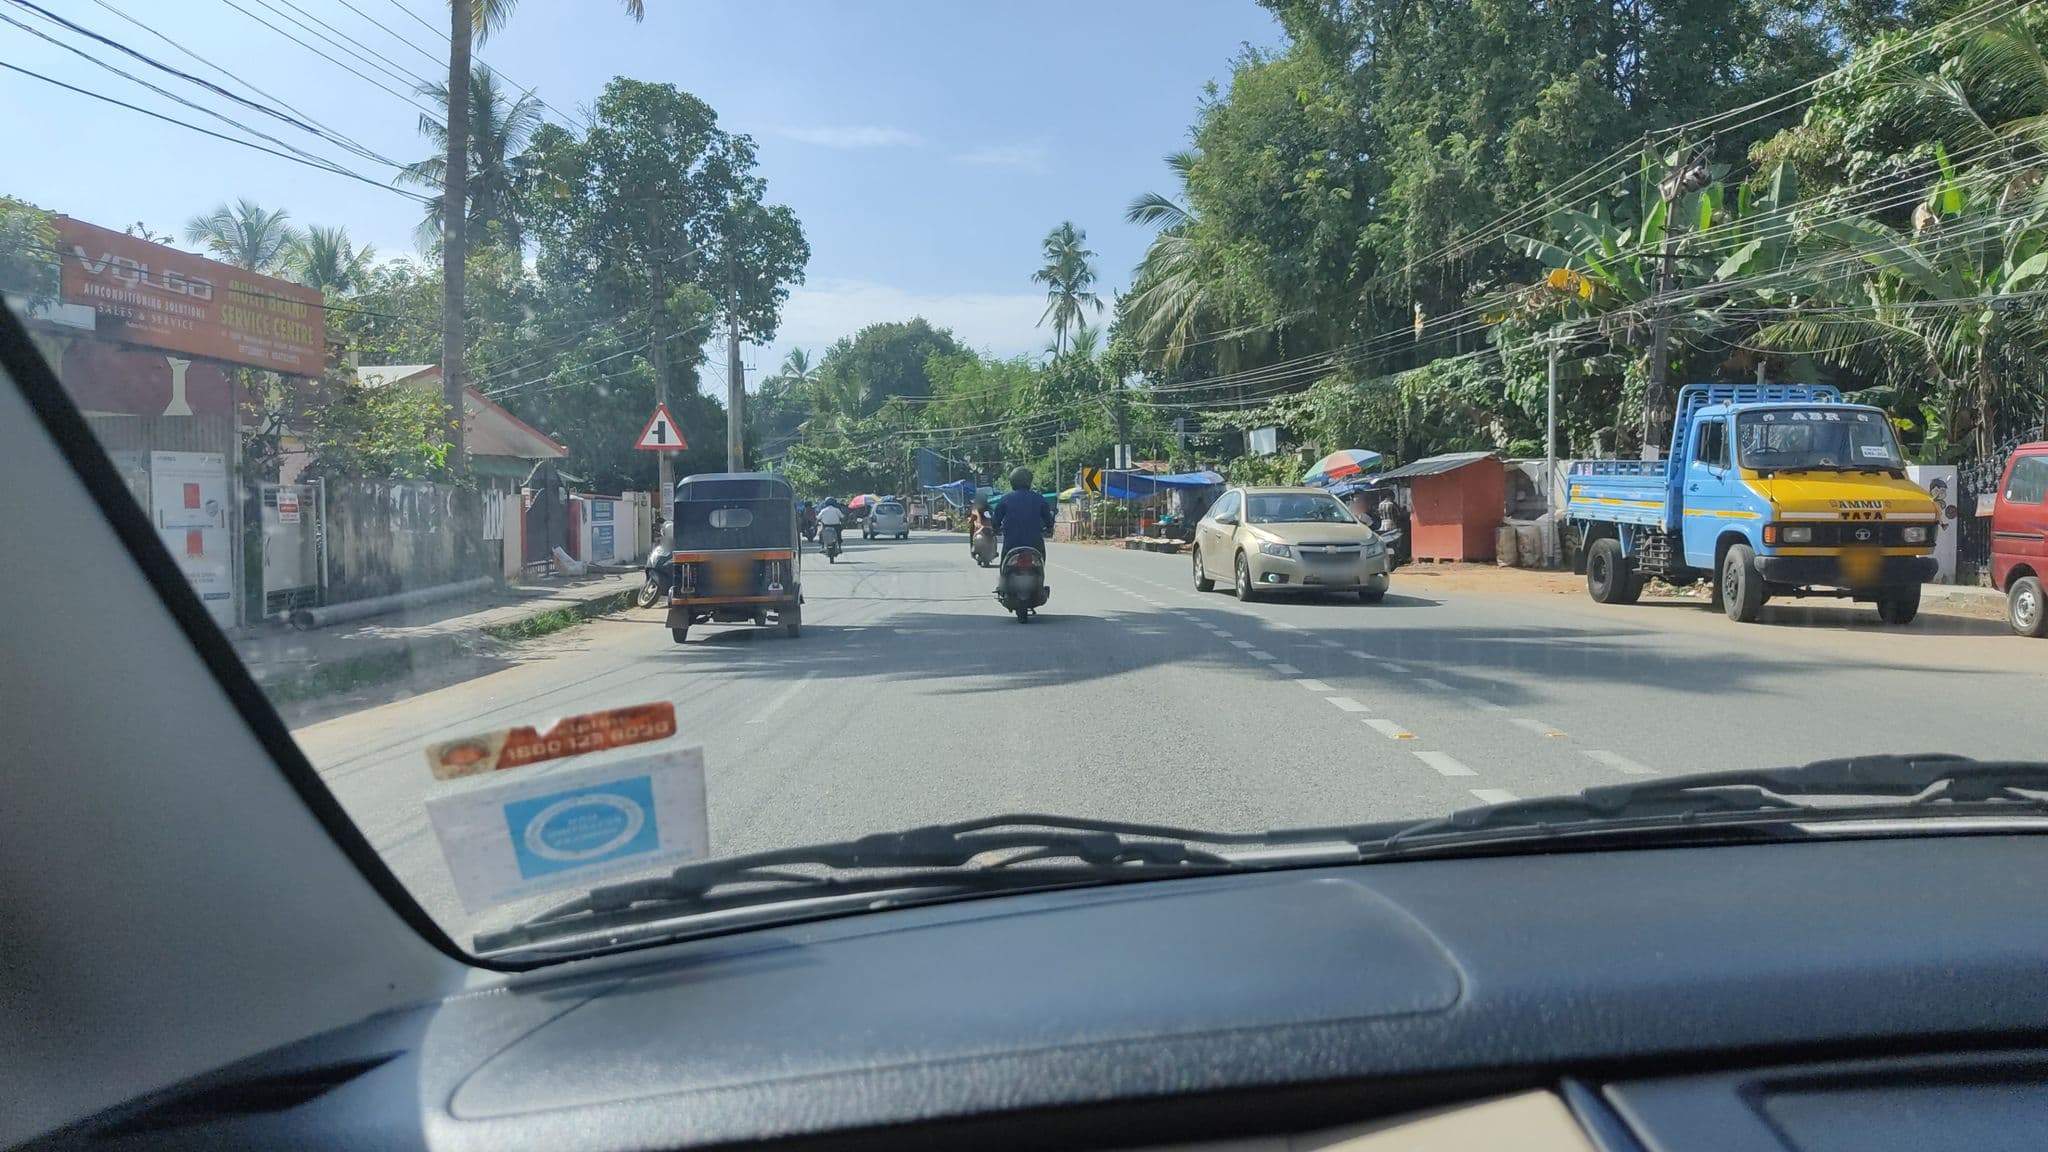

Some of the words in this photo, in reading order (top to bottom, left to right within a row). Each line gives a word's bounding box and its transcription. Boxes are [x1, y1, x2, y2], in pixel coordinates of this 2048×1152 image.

[97, 301, 133, 318] SALES
[151, 313, 193, 330] SERVICE
[222, 303, 270, 336] SERVICE
[273, 317, 314, 345] CENTRE
[1839, 500, 1882, 509] AMMU
[1841, 511, 1882, 520] TATA
